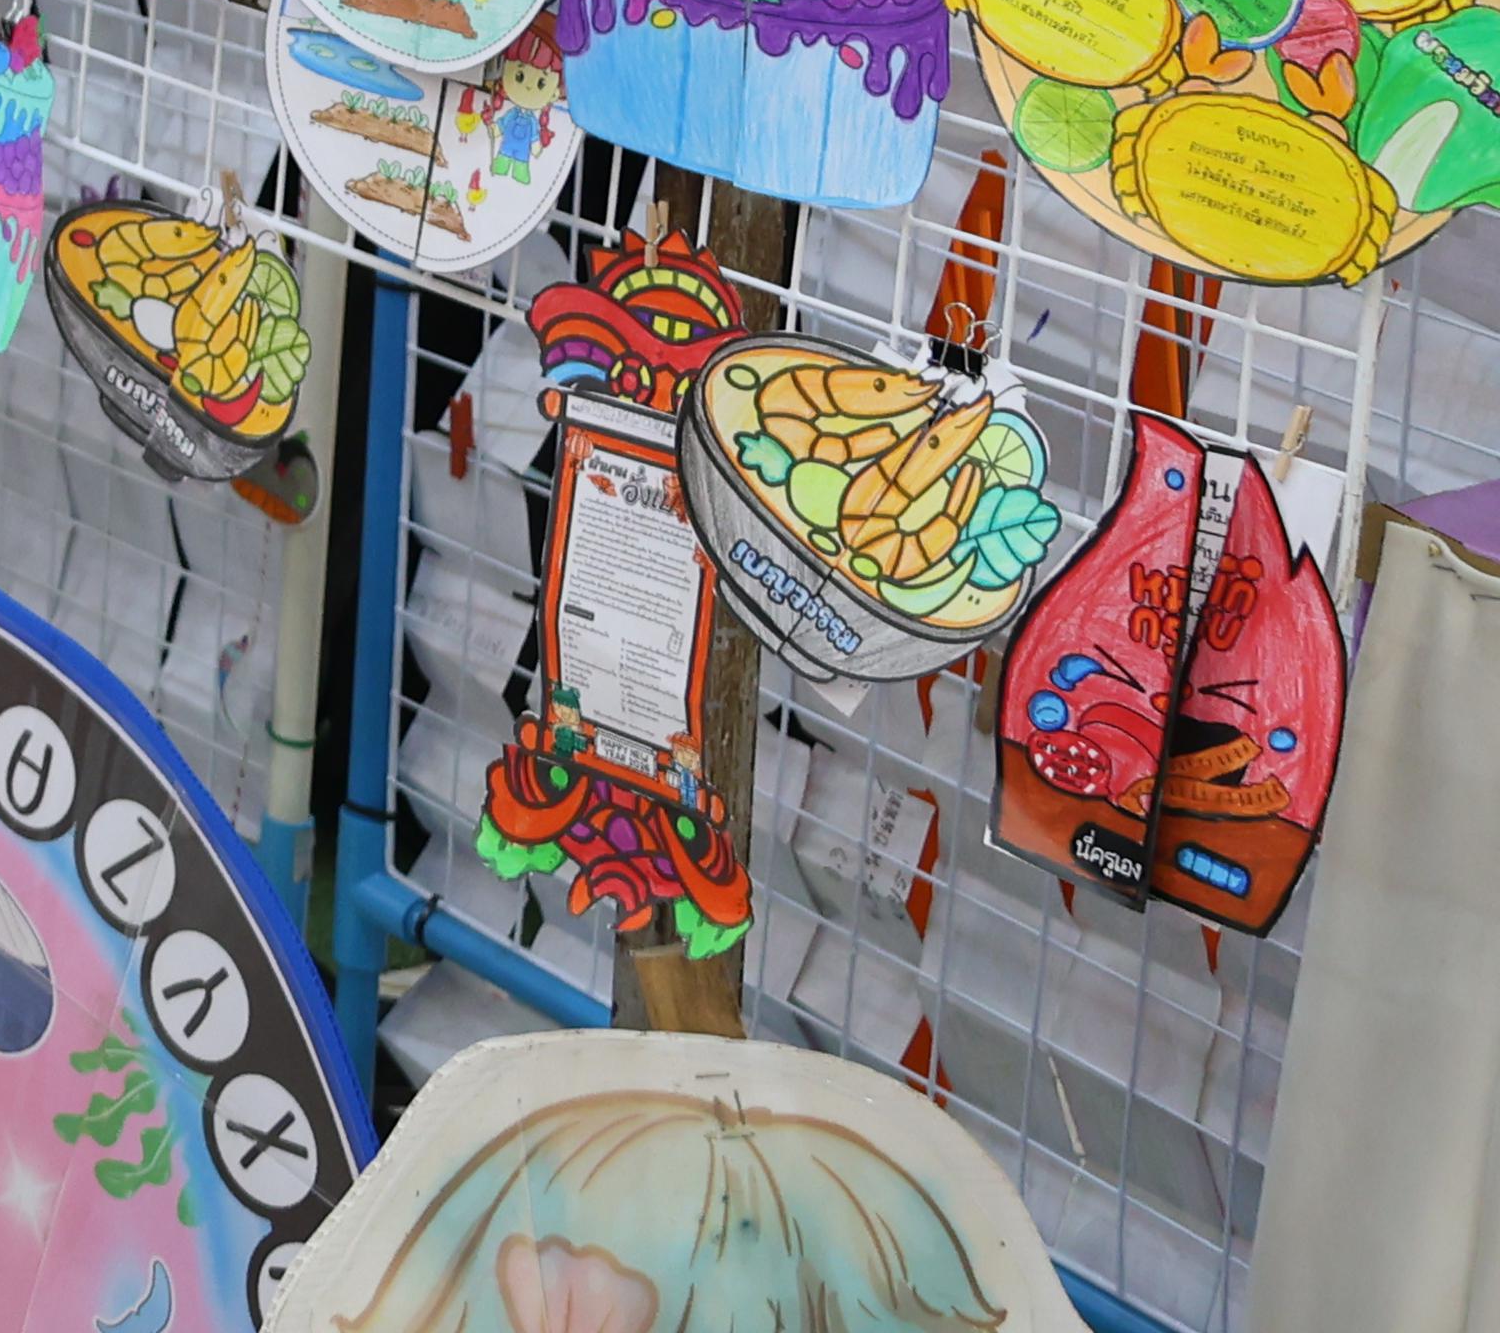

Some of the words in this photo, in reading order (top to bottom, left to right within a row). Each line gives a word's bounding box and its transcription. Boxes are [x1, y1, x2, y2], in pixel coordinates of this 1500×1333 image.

[620, 464, 677, 514] อั่งเป
[729, 538, 863, 656] เบญจธรรม
[6, 729, 54, 799] A
[99, 817, 167, 907] Z
[1075, 829, 1143, 882] นี่ครูเอง
[162, 966, 231, 1038] Y
[225, 1111, 310, 1172] X
